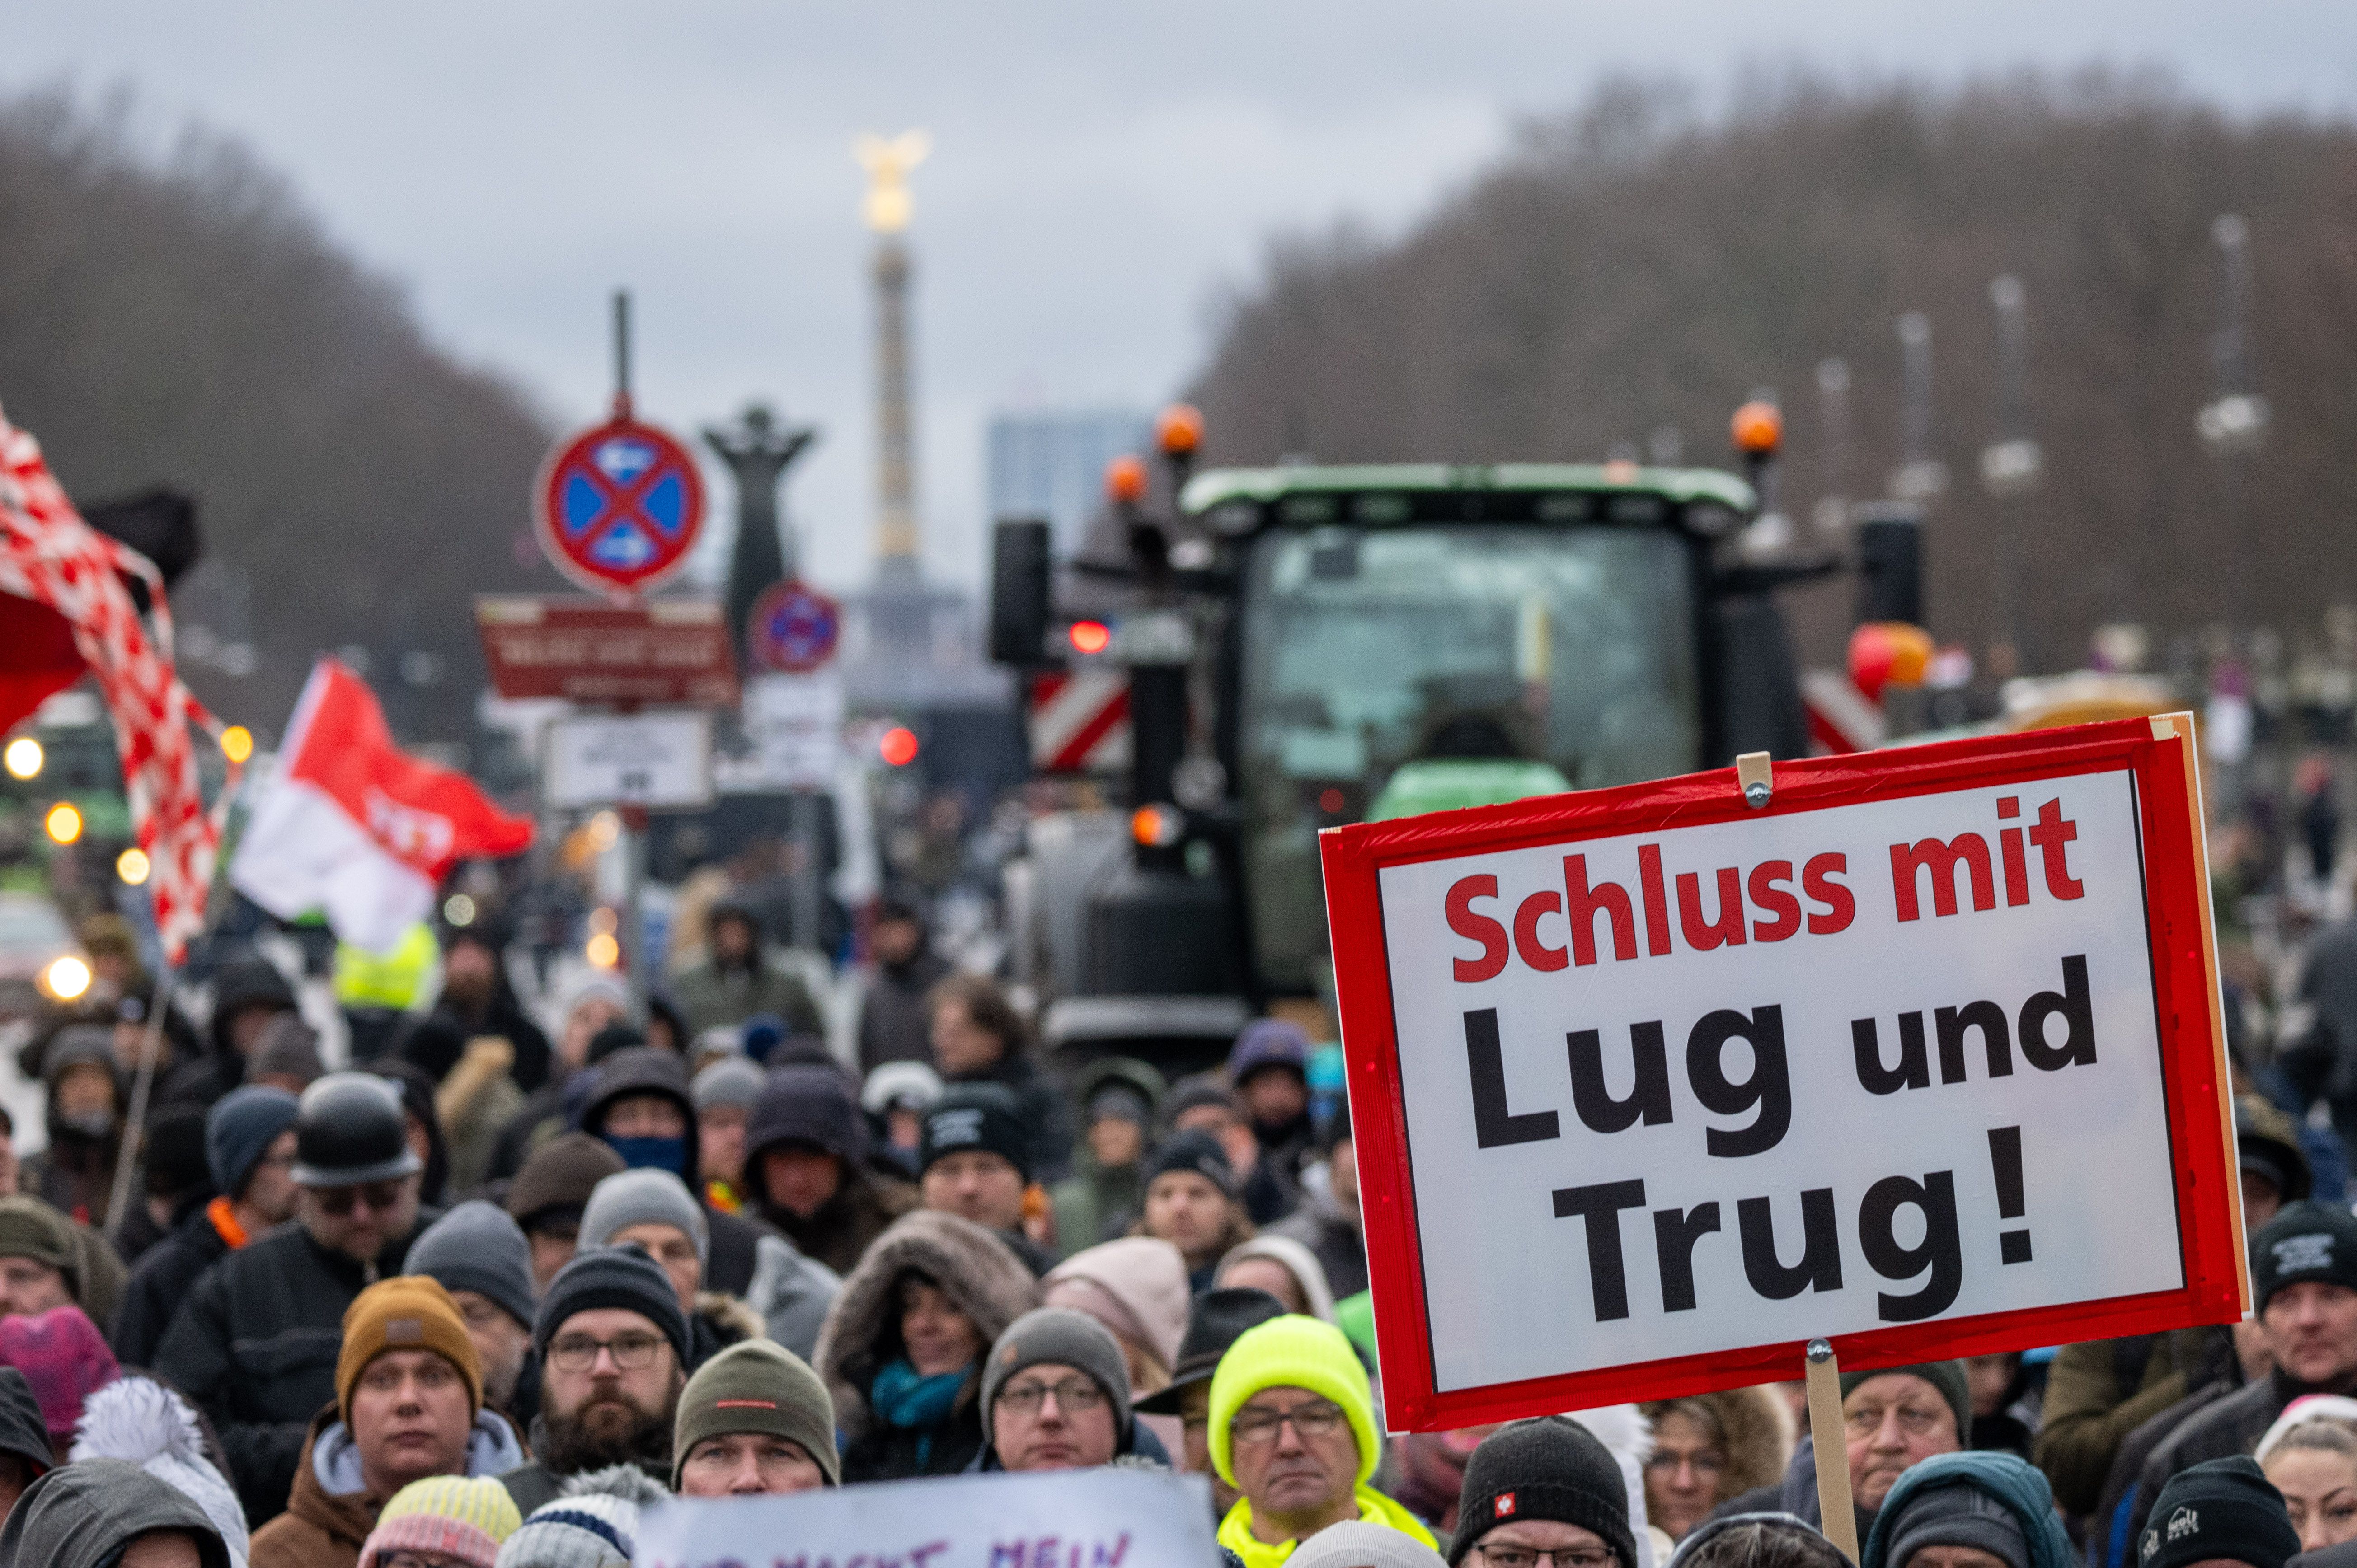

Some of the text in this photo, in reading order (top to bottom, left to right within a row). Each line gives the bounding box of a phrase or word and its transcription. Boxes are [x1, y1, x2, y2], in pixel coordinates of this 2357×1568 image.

[1445, 796, 2085, 983] Schluss mit
[1463, 954, 2098, 1158] Lug und
[1552, 1125, 2033, 1323] Trug!
